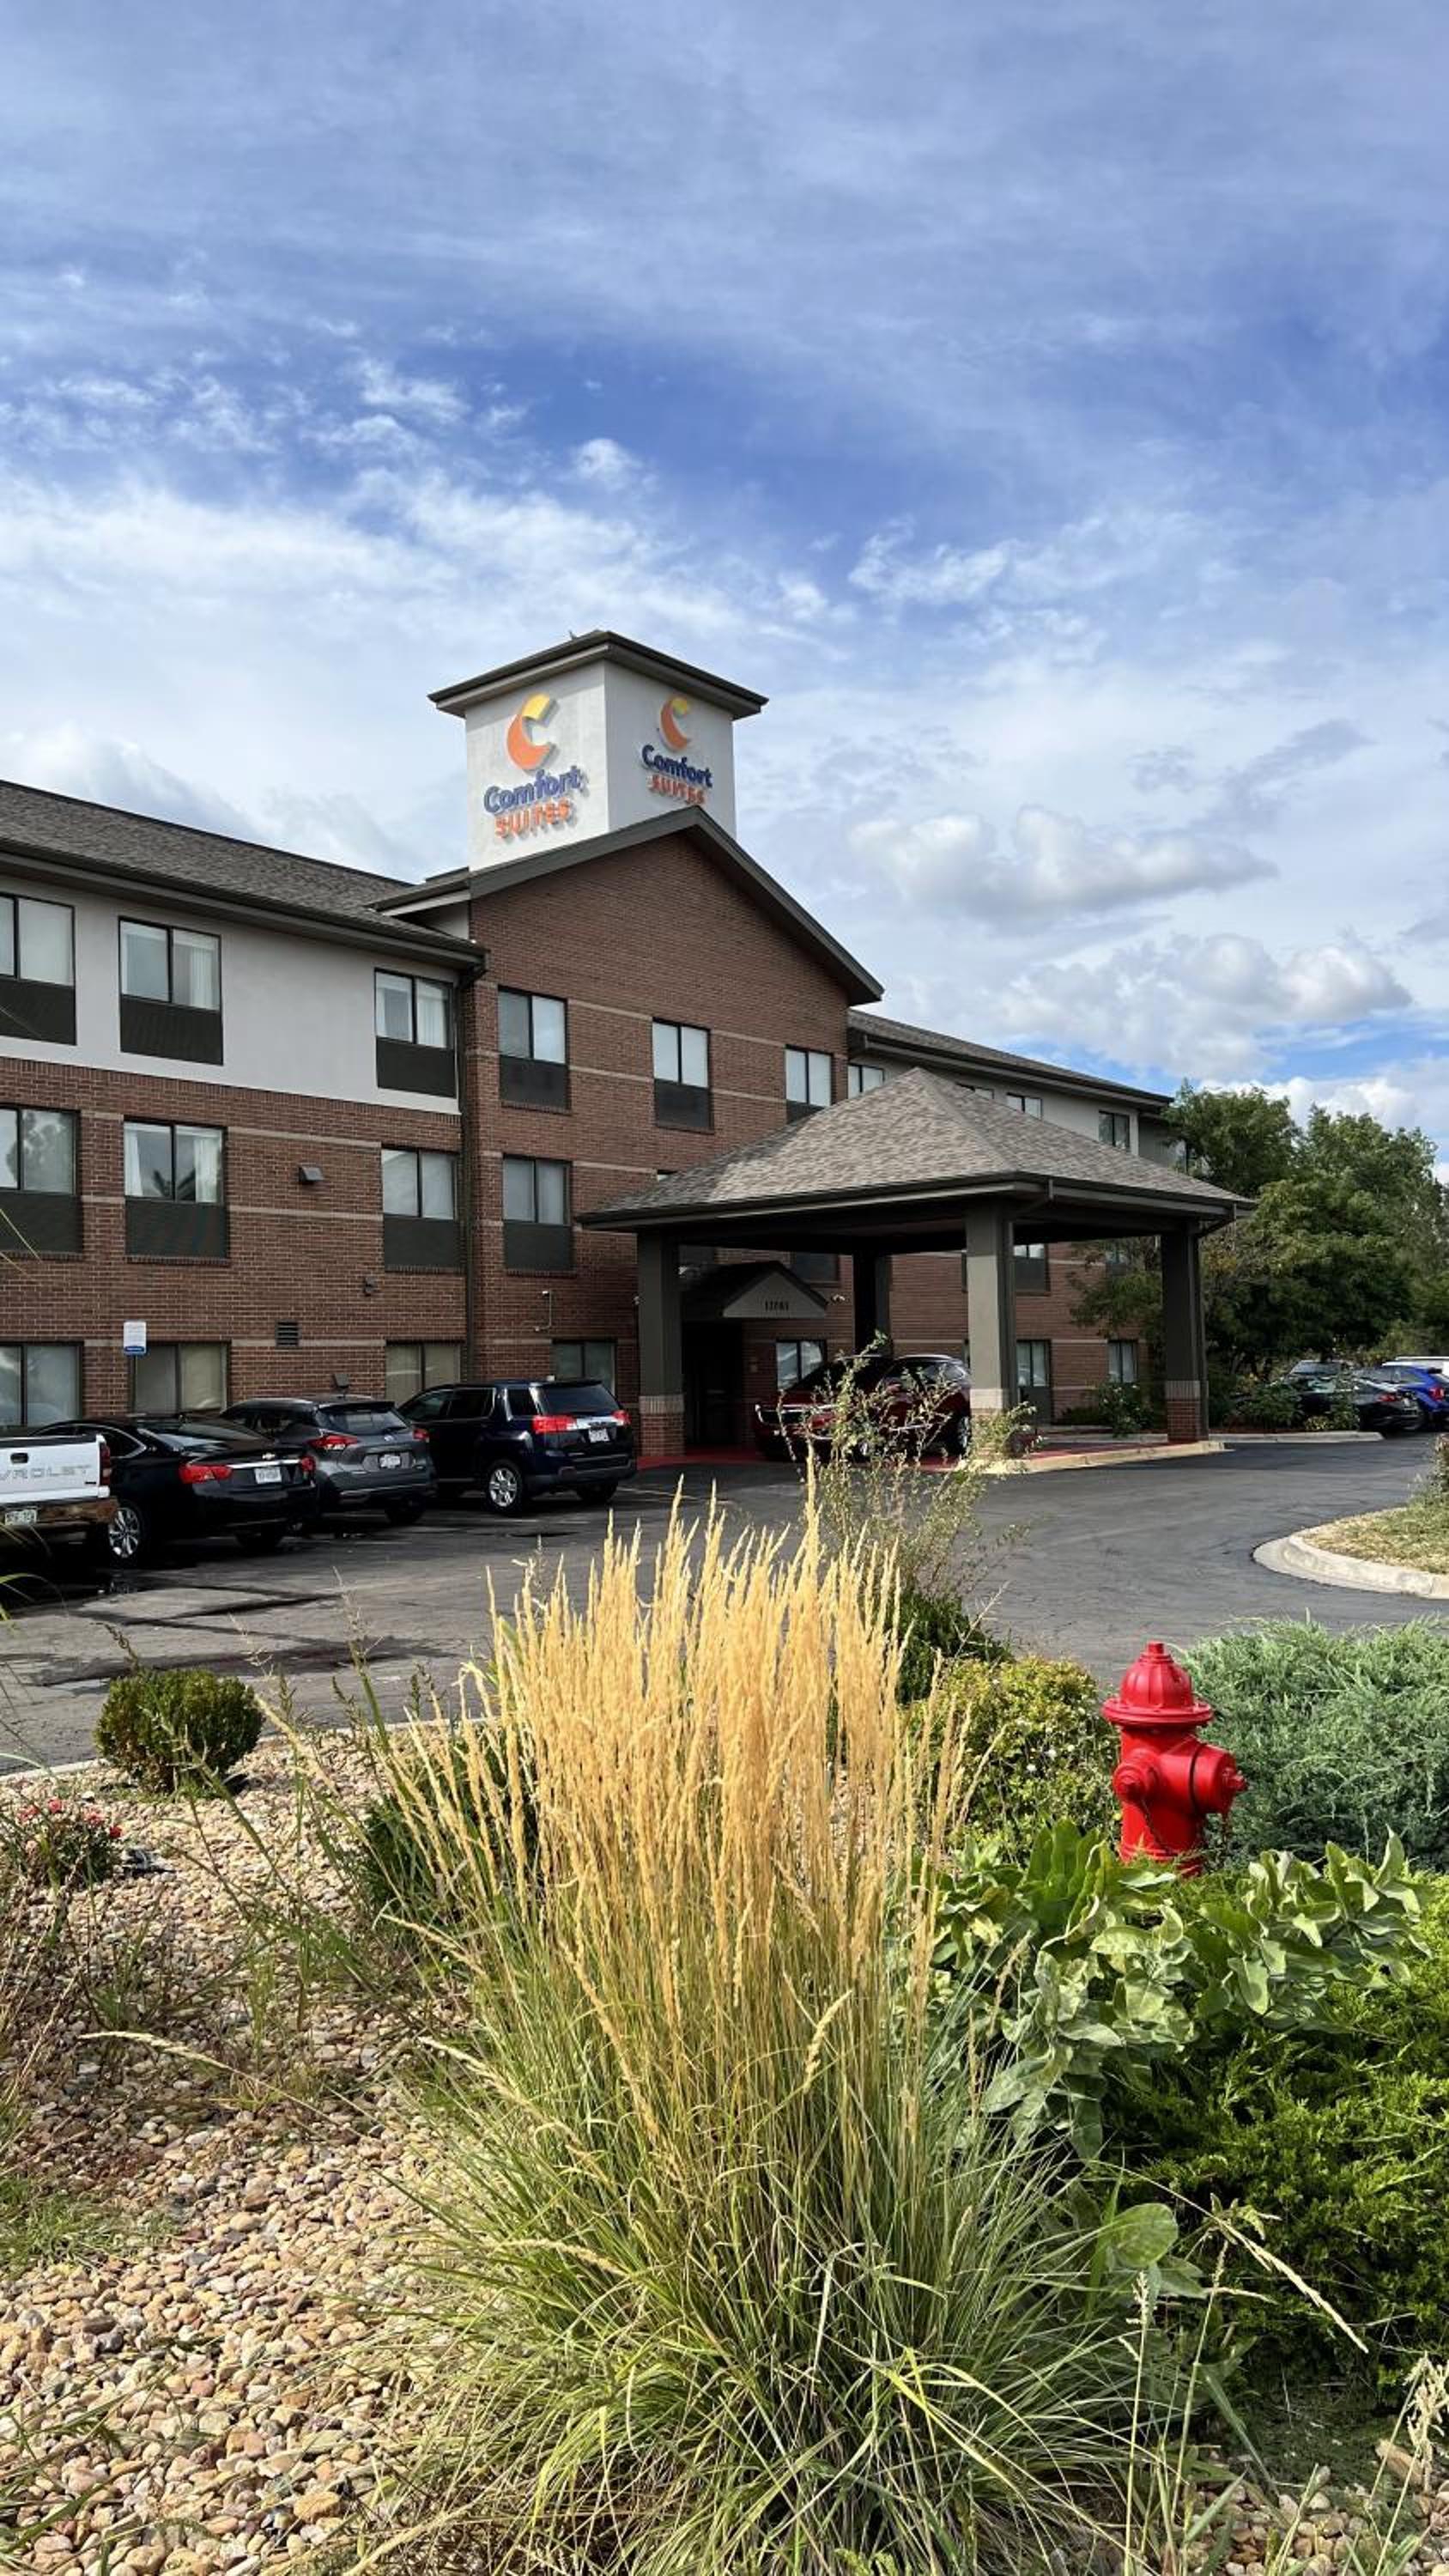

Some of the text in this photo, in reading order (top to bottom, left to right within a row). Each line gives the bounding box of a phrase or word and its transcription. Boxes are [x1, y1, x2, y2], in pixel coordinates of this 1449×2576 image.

[642, 744, 712, 788] Comfort
[483, 765, 582, 814] Comfort
[649, 774, 706, 805] SUITES
[494, 798, 571, 839] SUITES
